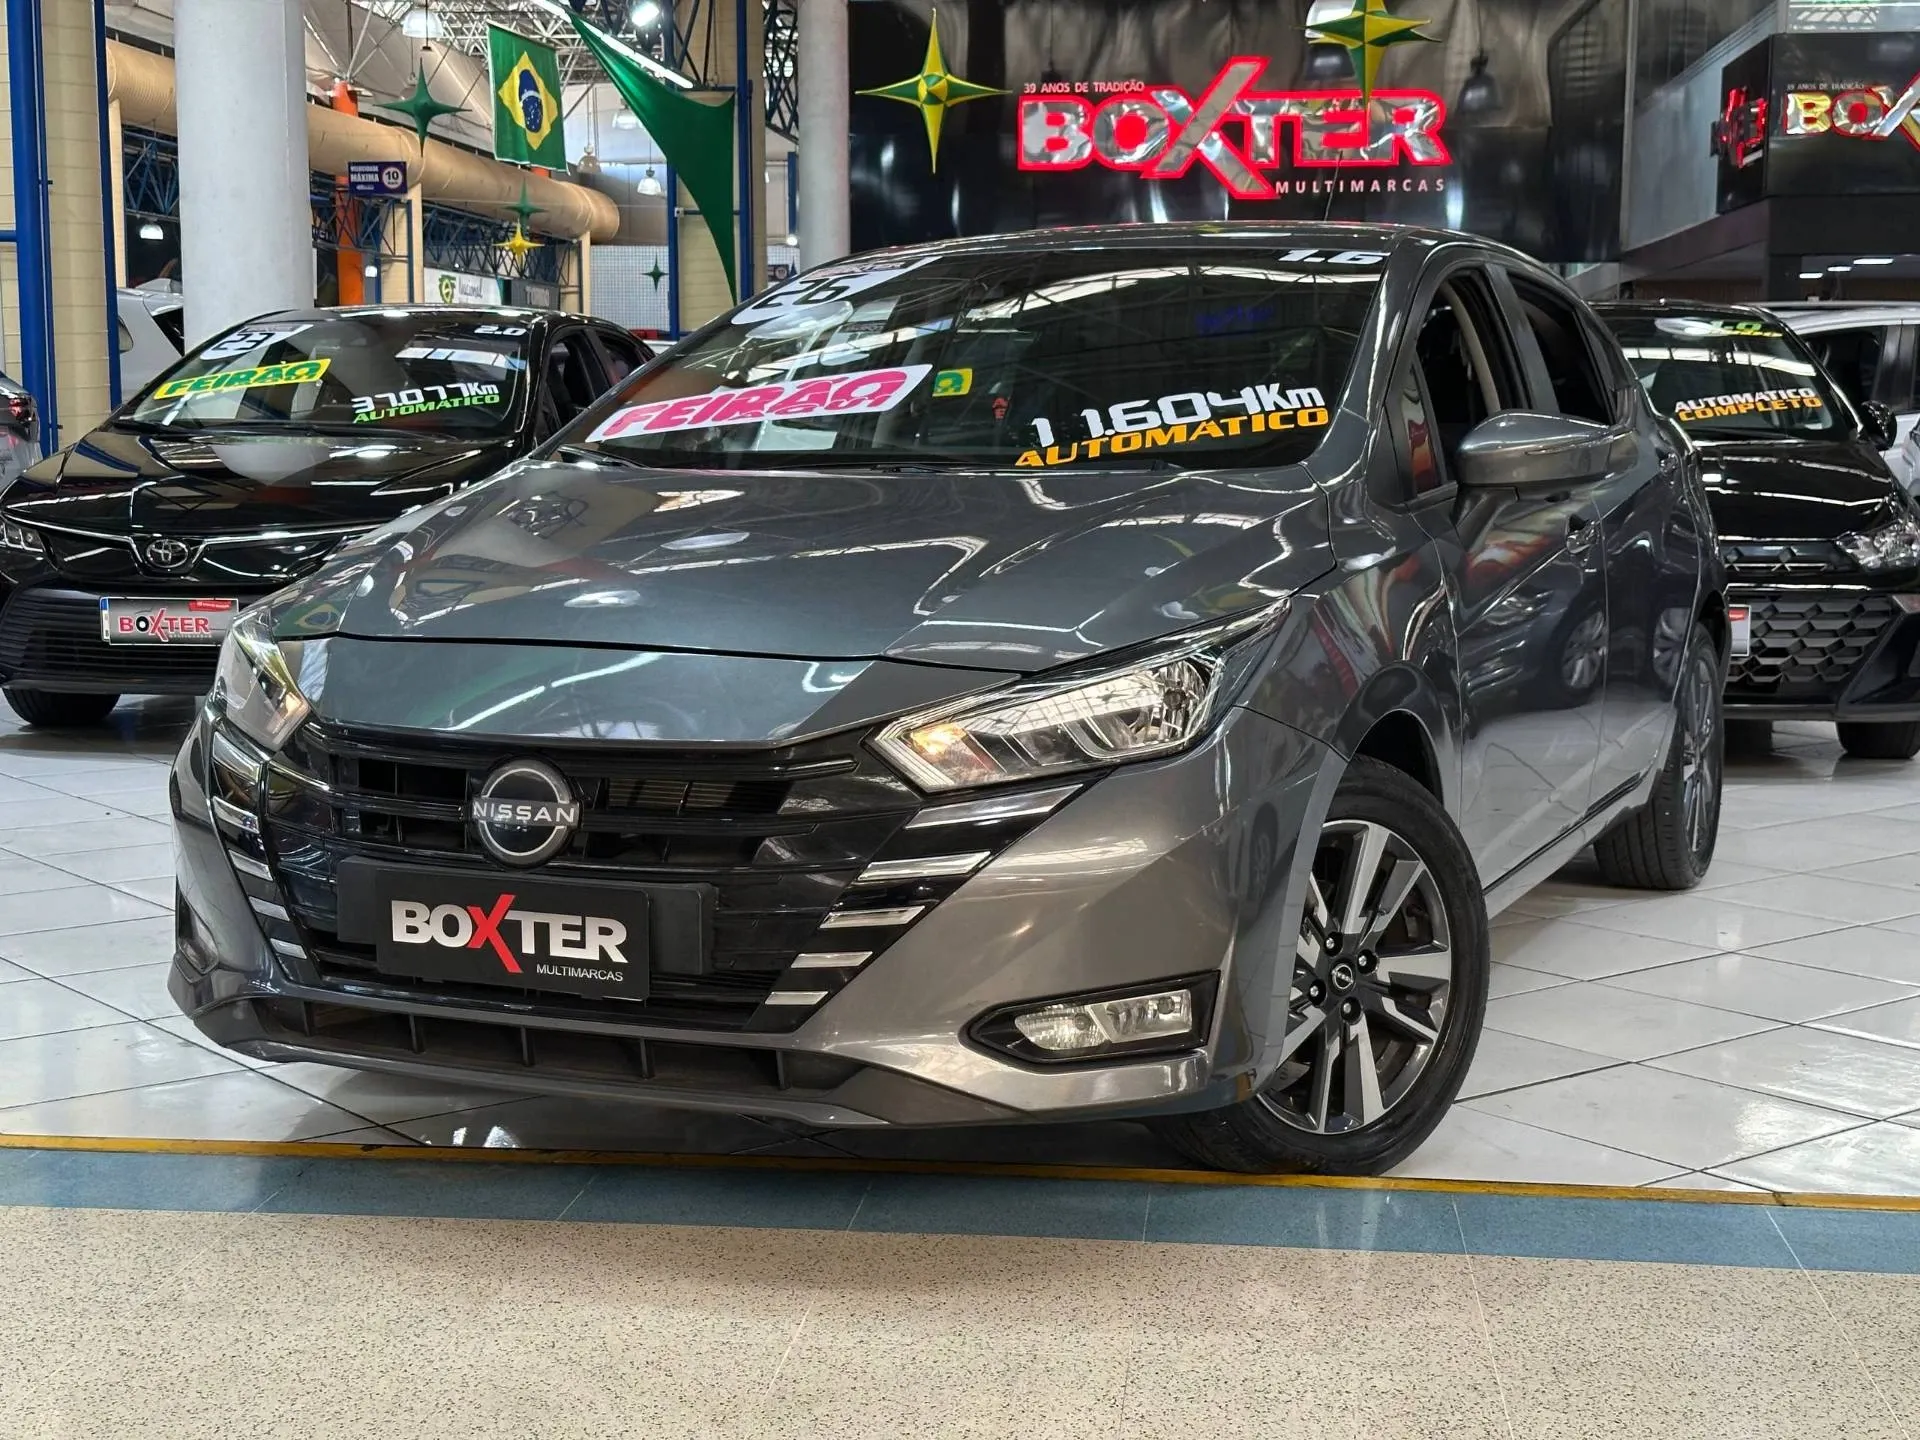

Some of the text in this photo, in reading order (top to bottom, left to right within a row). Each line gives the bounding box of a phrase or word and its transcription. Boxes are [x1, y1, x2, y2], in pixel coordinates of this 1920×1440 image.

[1023, 79, 1145, 93] 39 ANOS DE TRADIÇÃO
[1018, 56, 1452, 200] BOXTER
[385, 170, 400, 181] 10
[1275, 179, 1444, 194] MULTIMARCAS
[1278, 249, 1392, 265] 1.6
[474, 325, 527, 336] 2.0
[352, 394, 500, 424] AUTOMATICO
[1675, 387, 1817, 413] AUTOMATICO
[1678, 397, 1823, 422] COMPLETO
[1014, 407, 1330, 468] AUTOMATICO
[118, 607, 210, 643] BOXTER
[473, 800, 576, 824] NISSAN
[391, 893, 629, 974] BOXTER
[536, 962, 624, 982] MULTIMARCAS
